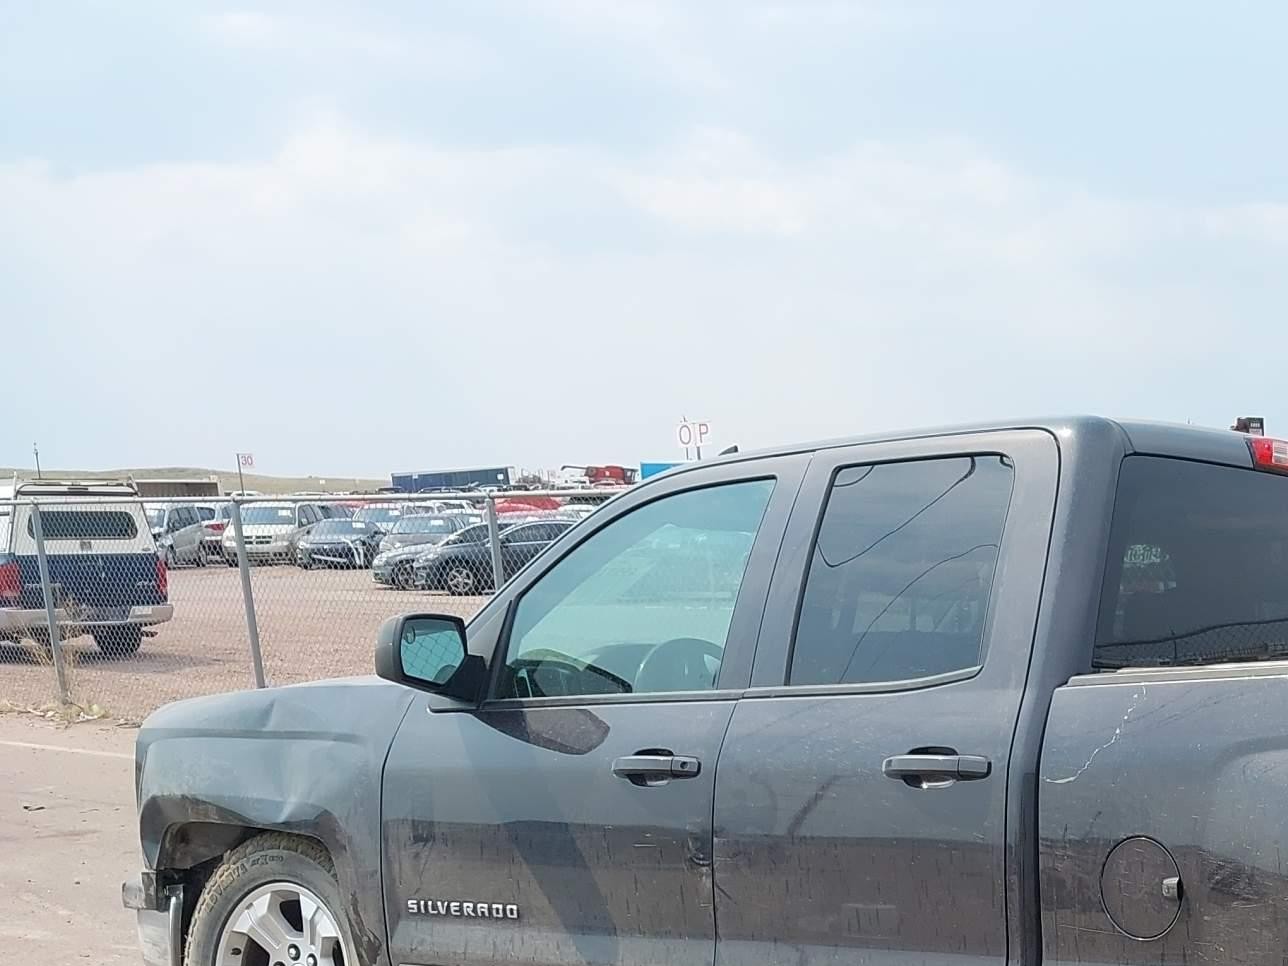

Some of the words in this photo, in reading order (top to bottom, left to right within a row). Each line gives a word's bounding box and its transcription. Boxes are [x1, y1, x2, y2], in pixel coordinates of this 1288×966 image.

[698, 423, 709, 444] P
[241, 455, 253, 466] 30
[407, 899, 518, 919] SILVERADO
